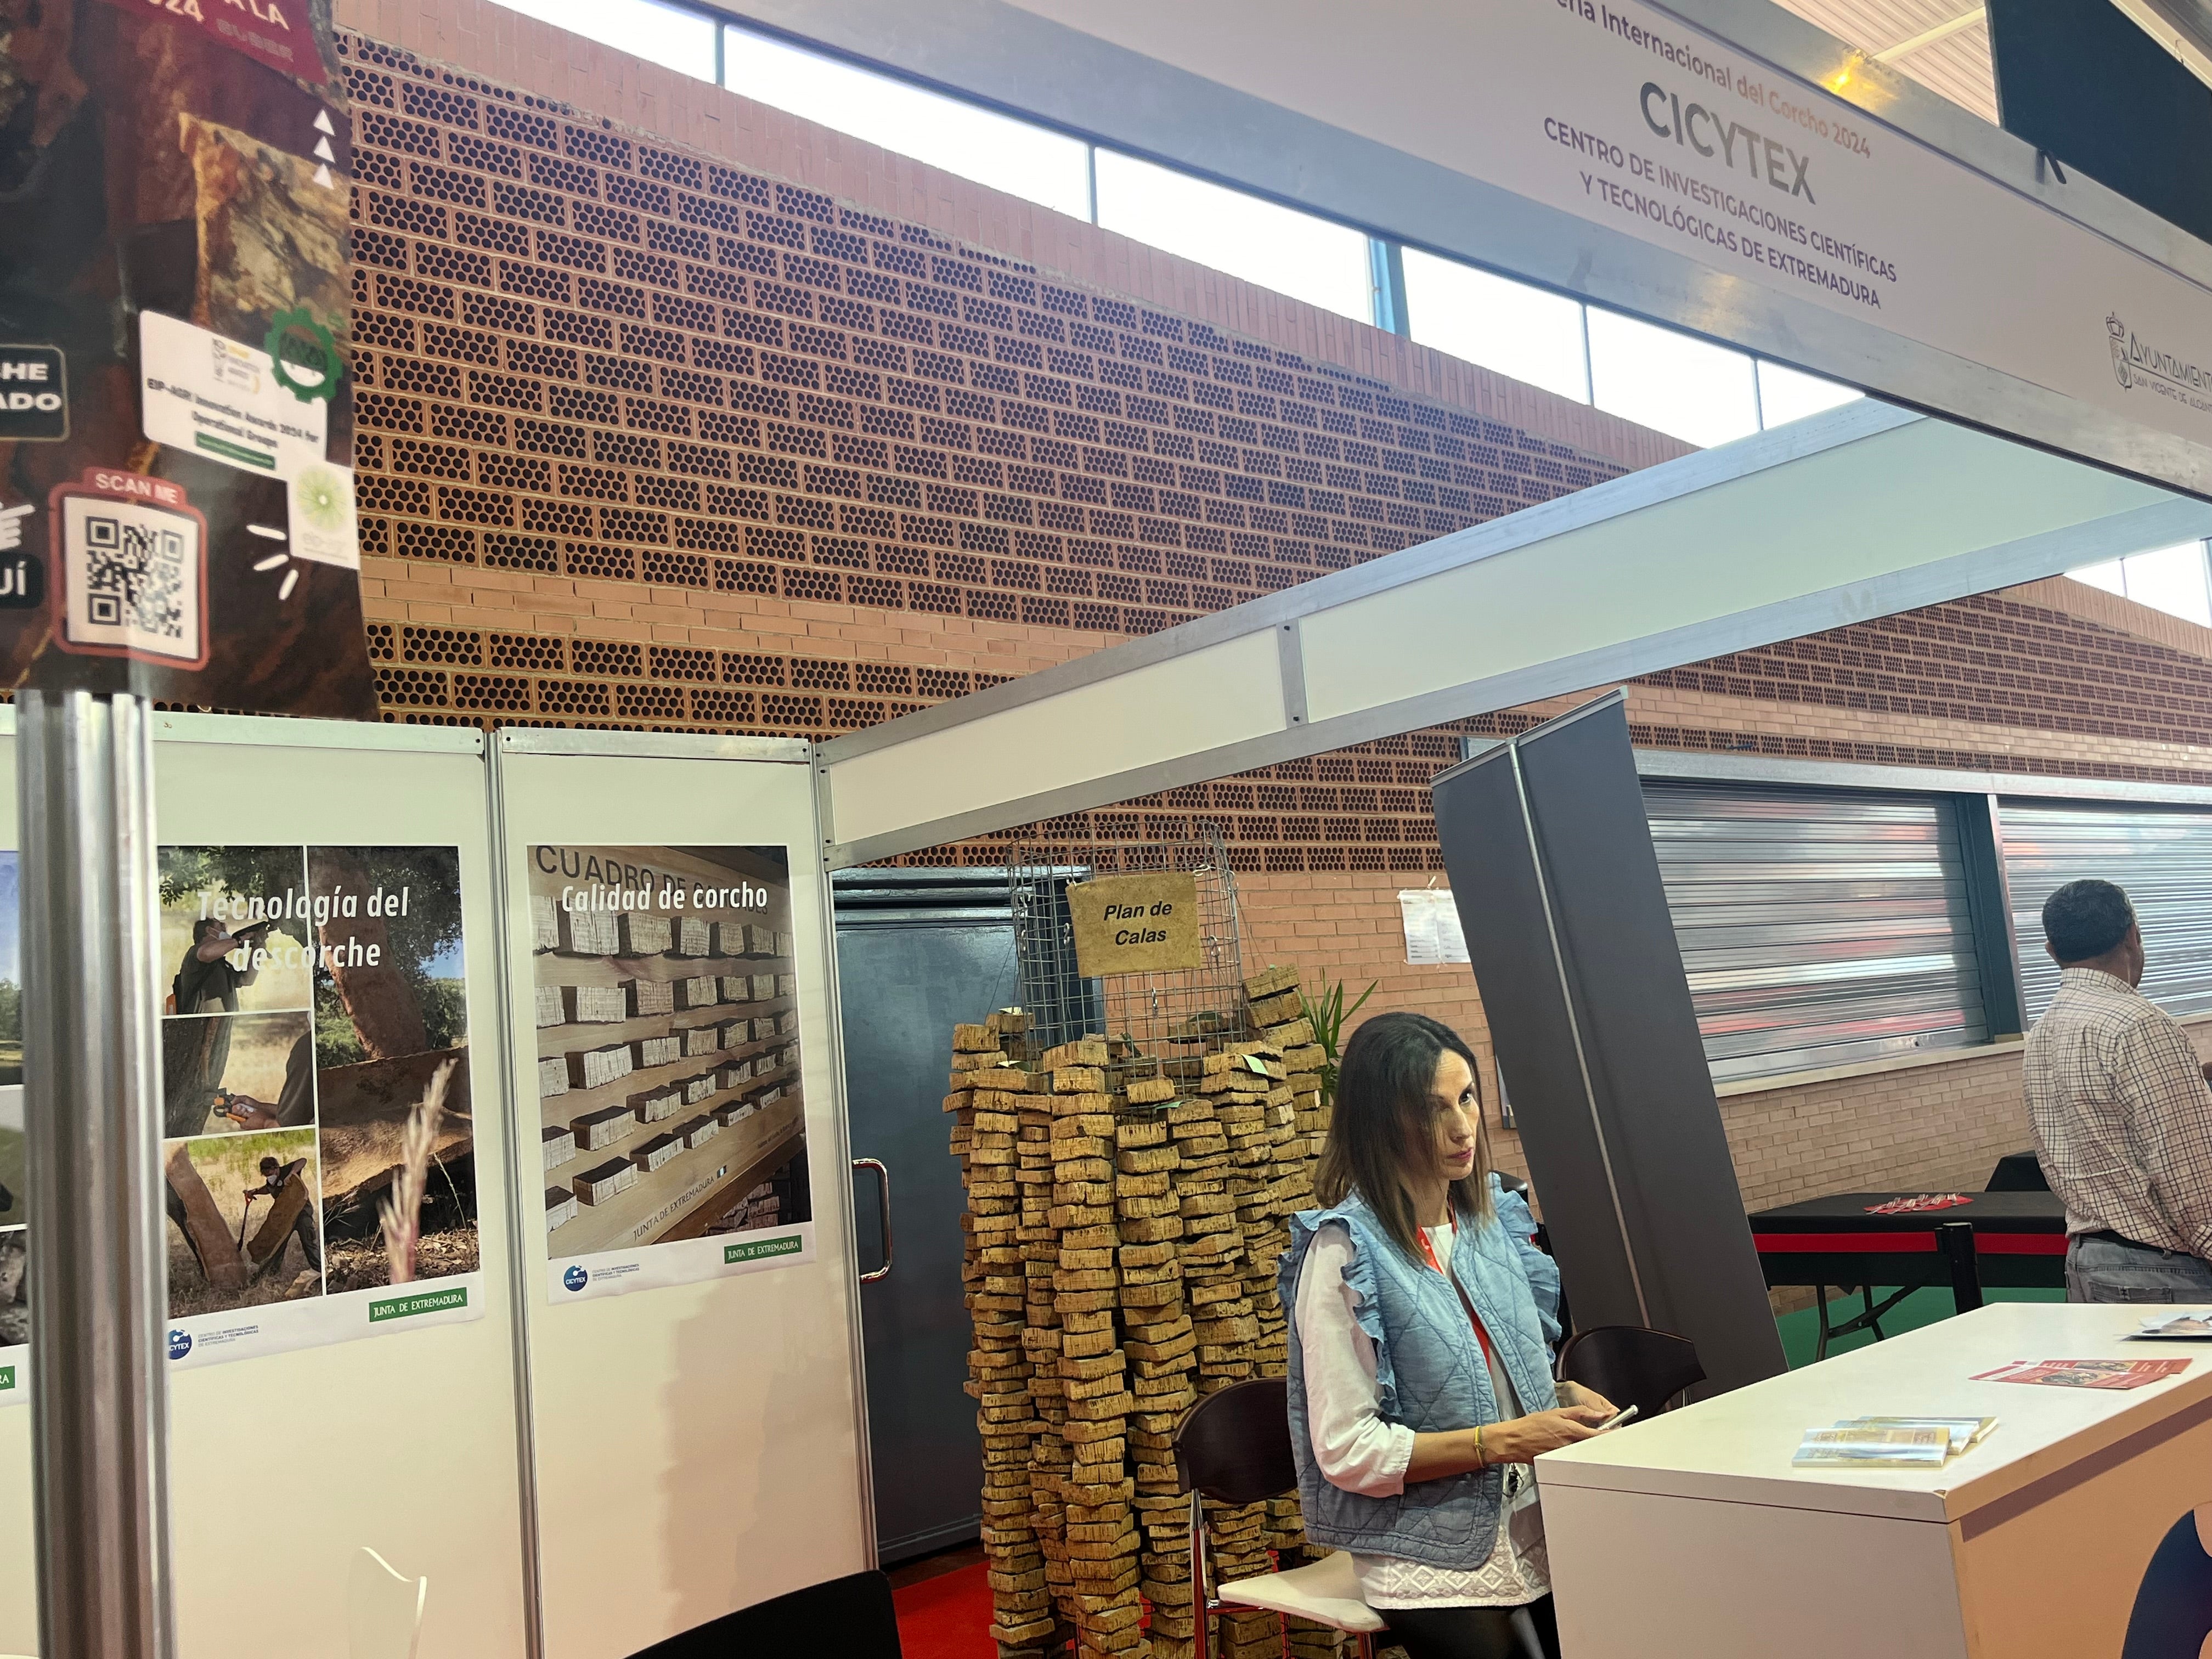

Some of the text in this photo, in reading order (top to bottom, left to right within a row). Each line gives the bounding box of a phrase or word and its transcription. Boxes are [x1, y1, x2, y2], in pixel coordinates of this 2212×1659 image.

[1601, 4, 1732, 91] Internacional
[1737, 76, 1764, 106] del
[1769, 91, 1829, 138] Corcho
[1832, 122, 1870, 159] 2024
[1639, 82, 1815, 205] CICYTEX
[1544, 117, 1897, 283] CENTRO DE INVESTIGACIONES CIENTÍFICAS
[1579, 171, 1881, 309] Y TECNOLÓGICAS DE EXTREMADURA
[2130, 331, 2212, 393] AYUNTAMIENT
[2133, 374, 2148, 388] SAN
[2149, 380, 2177, 400] VICENTE
[95, 473, 152, 496] SCAN
[536, 845, 655, 893] CUADRO
[197, 885, 409, 926] Tecnología del
[562, 882, 651, 912] Calidad
[658, 882, 685, 910] de
[693, 881, 768, 909] corcho
[1104, 900, 1172, 921] Plan de
[232, 936, 381, 972] descorche
[1115, 928, 1167, 945] Calas
[633, 1176, 715, 1242] JUNTA DE EXTREMADURA
[727, 1241, 799, 1260] JUNTA DE EXTREMADURA
[565, 1277, 586, 1285] CICYTEX
[373, 1294, 463, 1318] JUNTA DE EXTREMADURA
